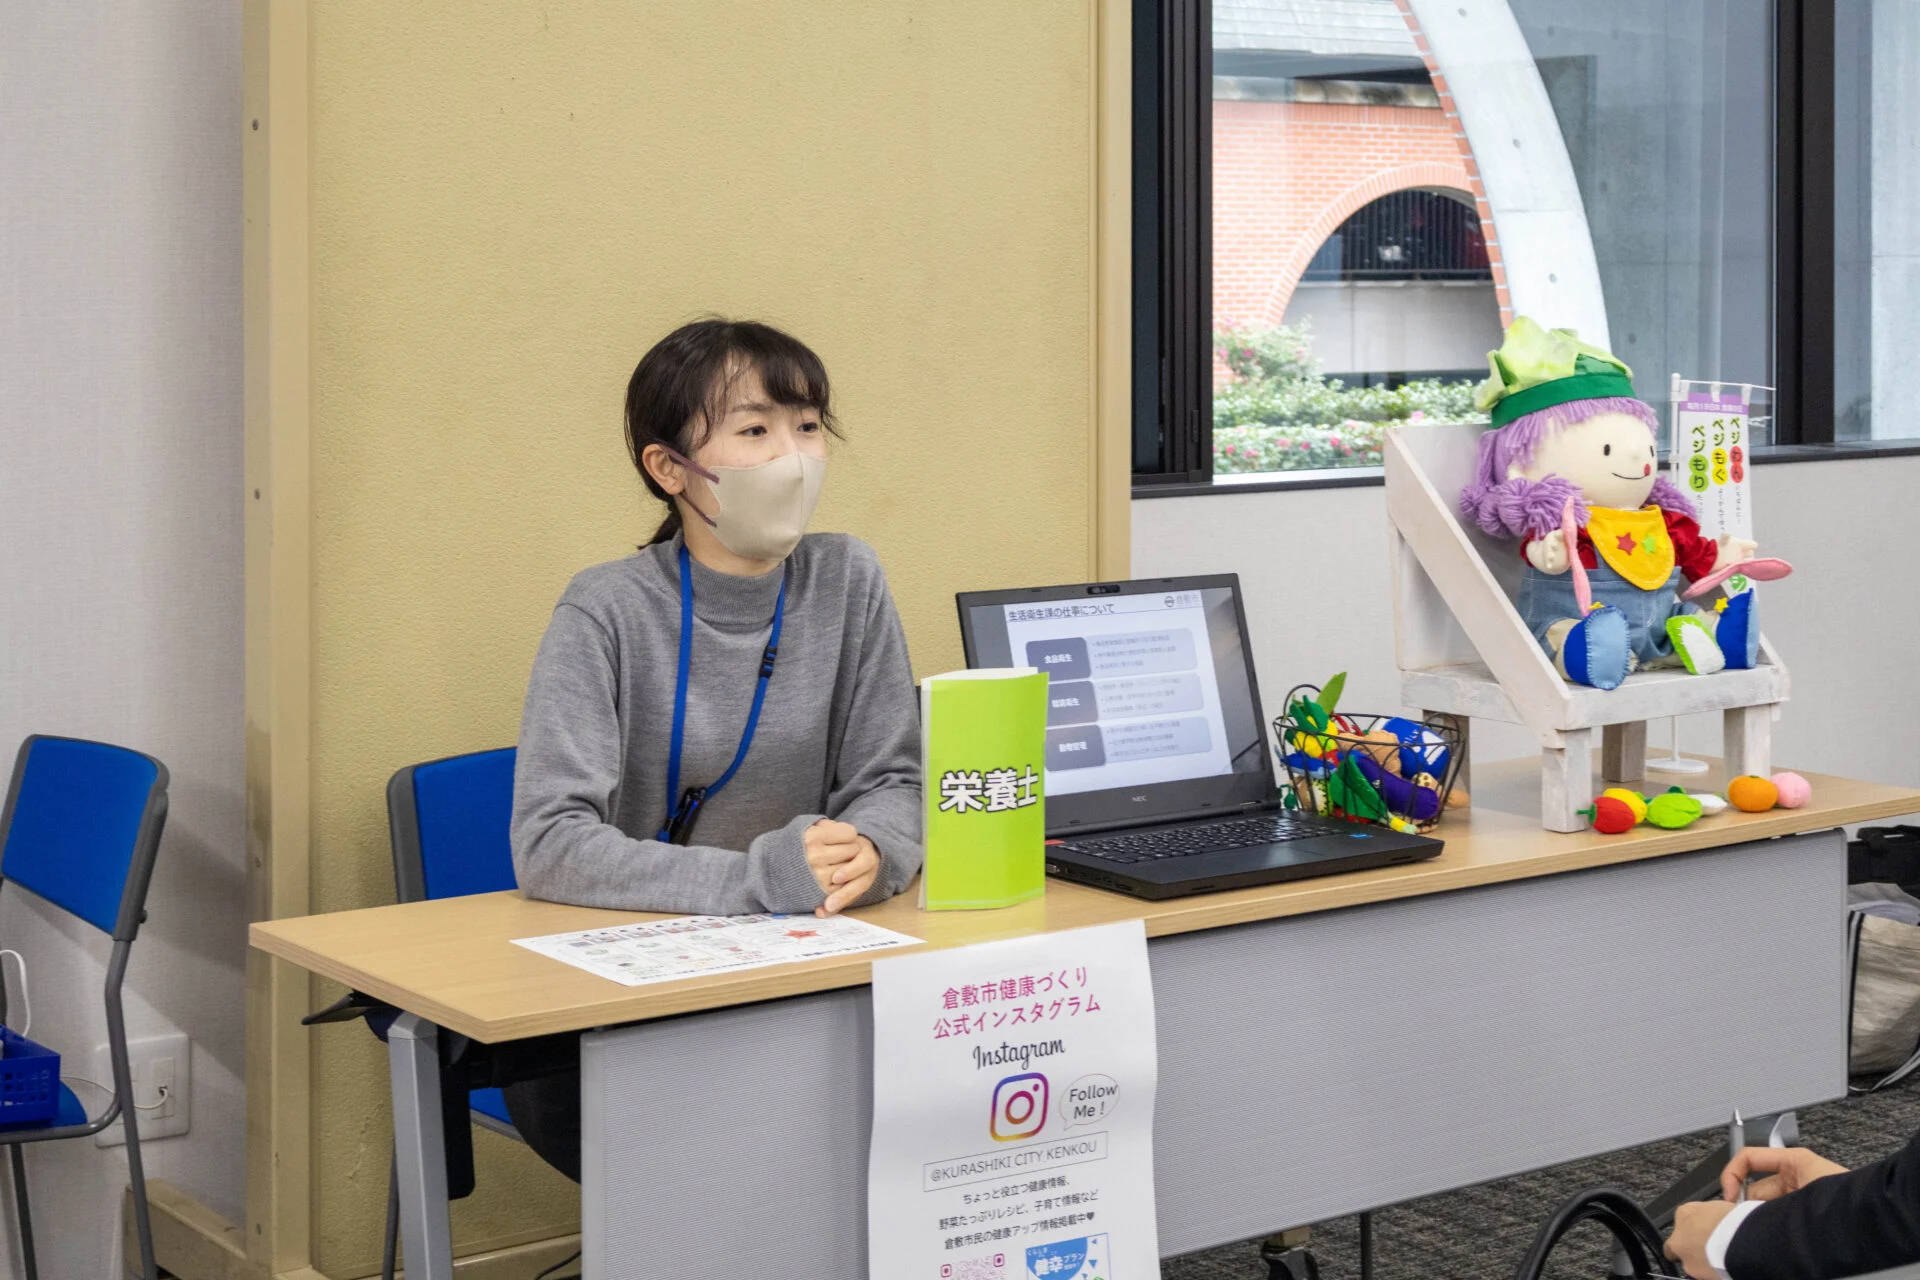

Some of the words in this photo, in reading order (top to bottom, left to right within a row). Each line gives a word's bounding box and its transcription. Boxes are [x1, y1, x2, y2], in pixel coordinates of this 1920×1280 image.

[1691, 425, 1707, 489] ベジもり
[1712, 419, 1726, 481] ベジもぐ
[1730, 416, 1743, 480] ベジわん
[1008, 603, 1115, 621] 生活衛生課の仕事について
[940, 765, 1039, 813] 栄養士
[942, 966, 1087, 1010] 倉敷市健康づくり
[933, 994, 1101, 1039] 公式インスタグラム
[972, 1039, 1066, 1071] Instagram
[1069, 1084, 1118, 1102] Follow
[963, 1176, 1070, 1204] ちょっと役立つ健康情報、
